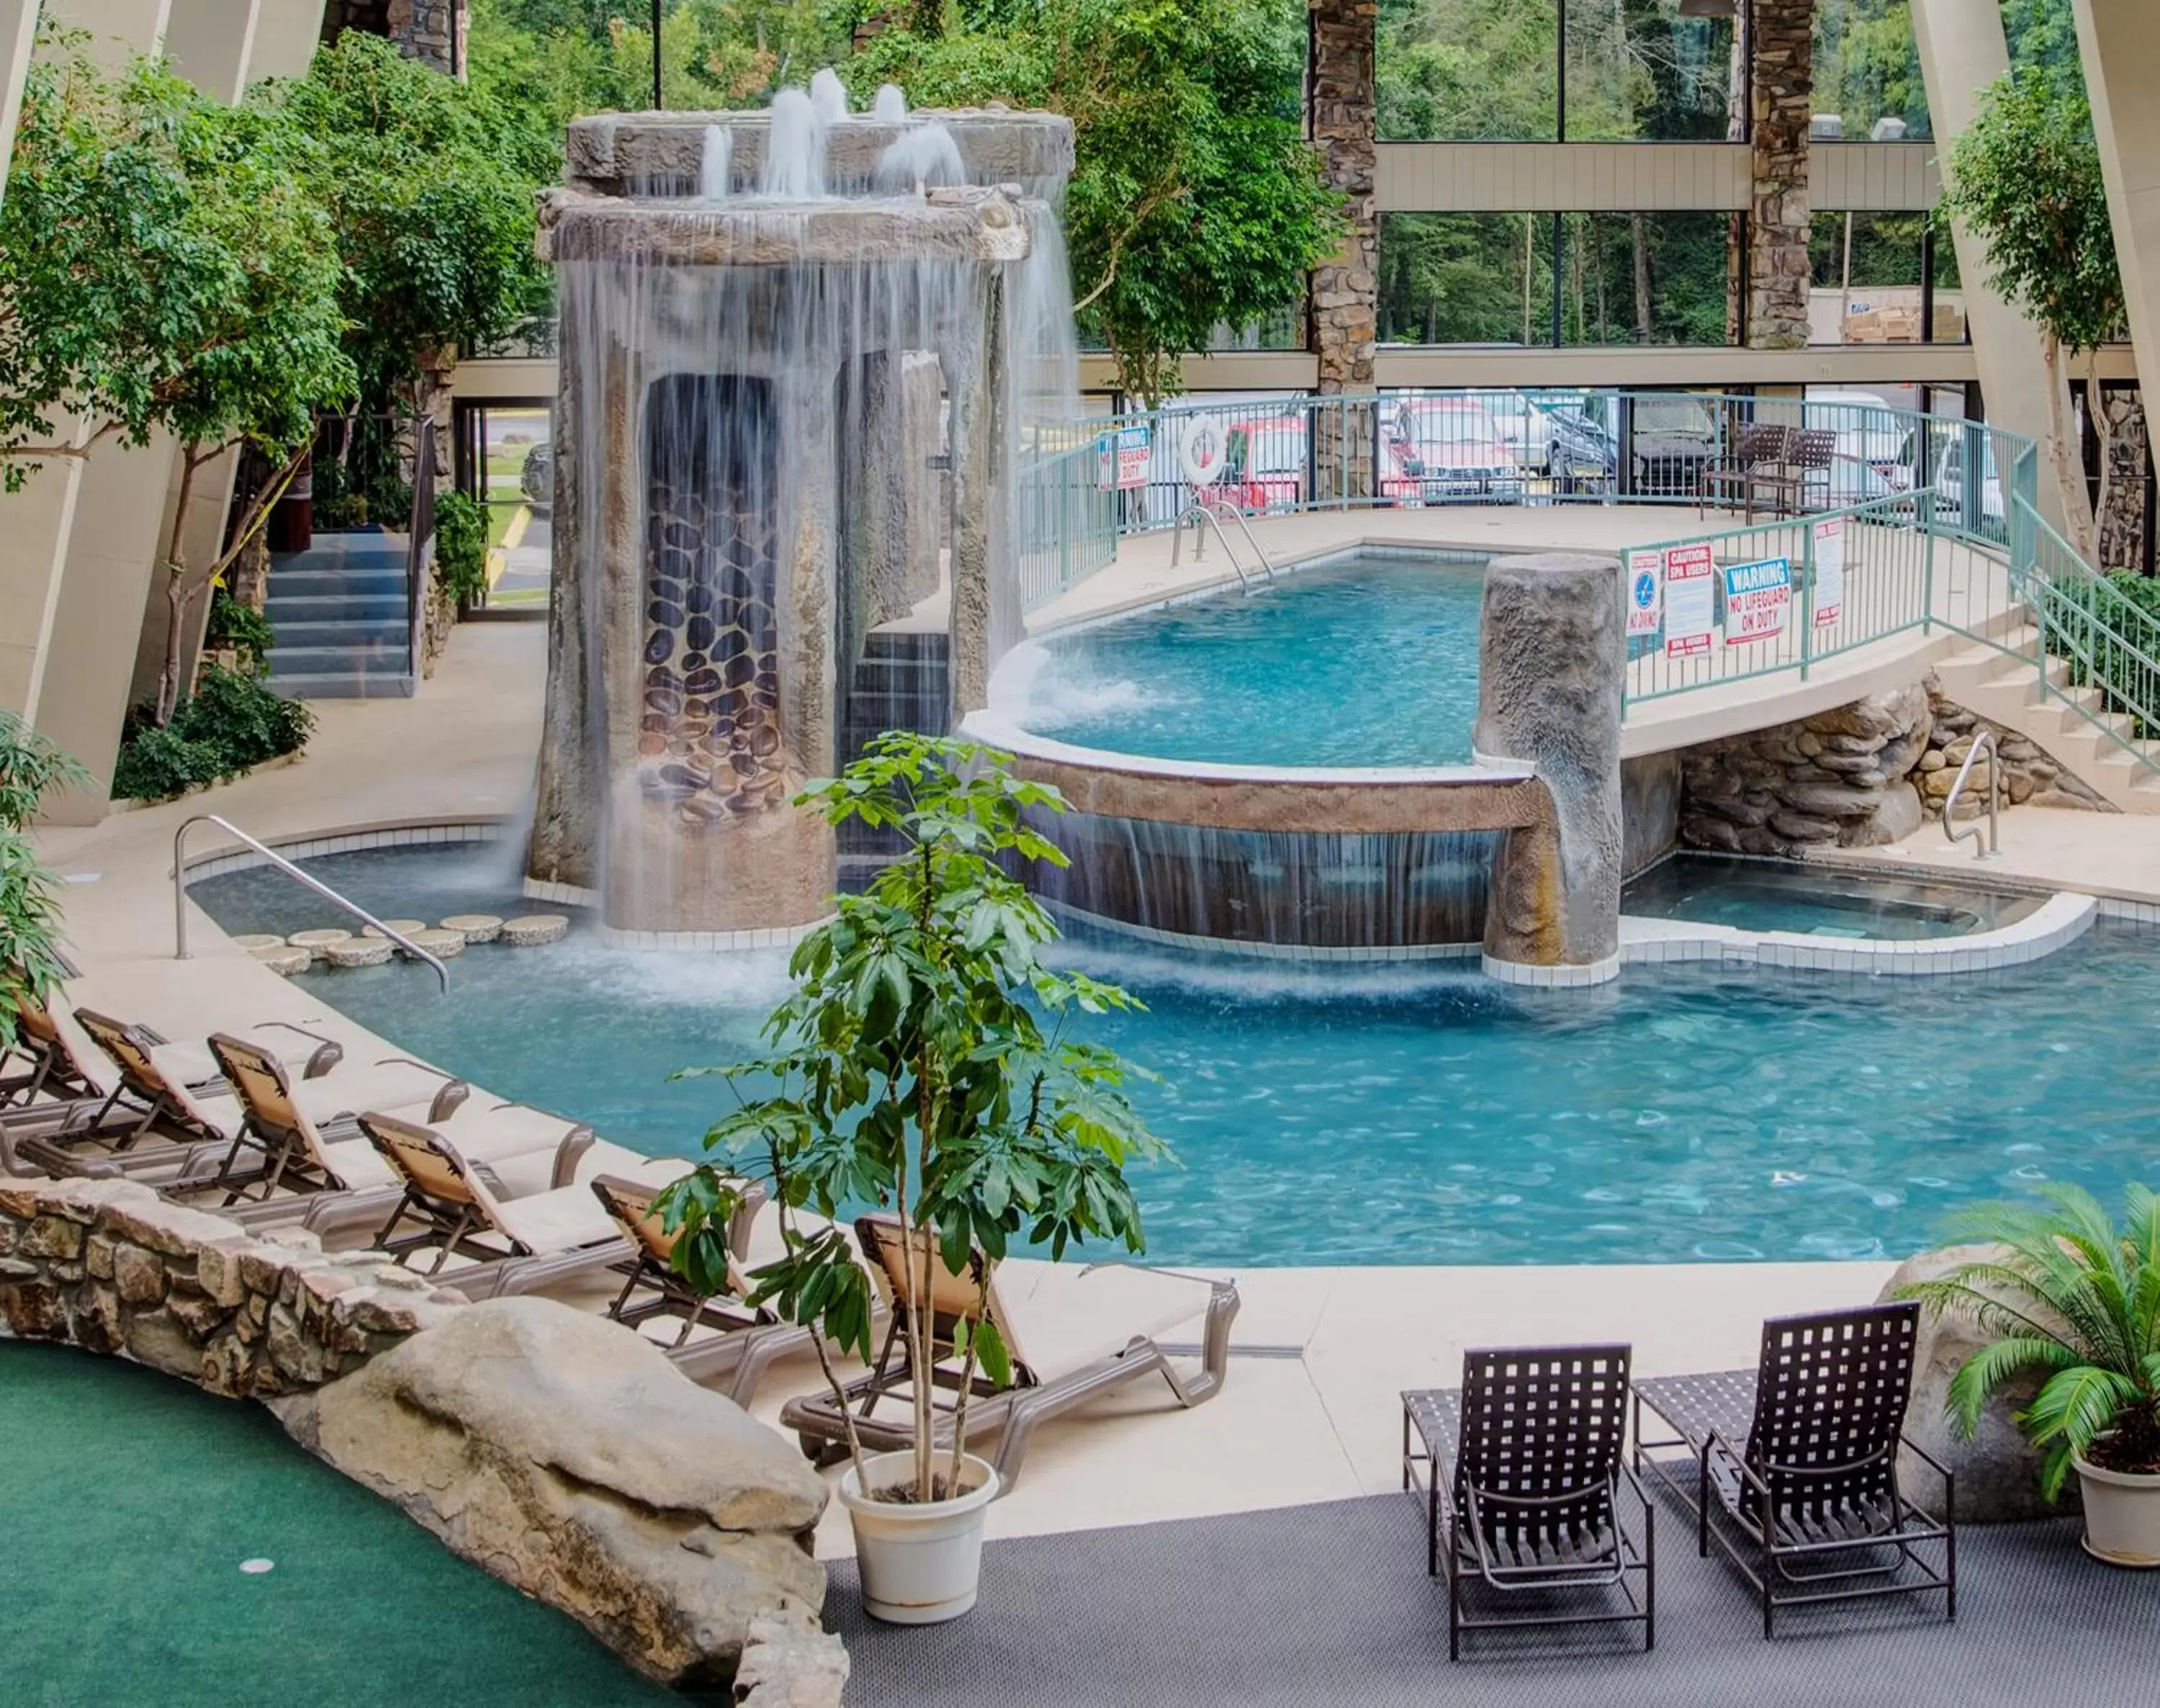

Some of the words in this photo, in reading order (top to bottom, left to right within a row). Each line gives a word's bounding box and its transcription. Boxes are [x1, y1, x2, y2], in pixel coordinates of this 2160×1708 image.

[1670, 565, 1685, 580] SPA
[1686, 562, 1709, 576] USERS
[1730, 562, 1786, 591] WARNING
[1730, 595, 1741, 614] NO
[1745, 586, 1788, 611] LIFEGUARD
[1742, 614, 1754, 631] ON
[1758, 609, 1778, 629] DUTY
